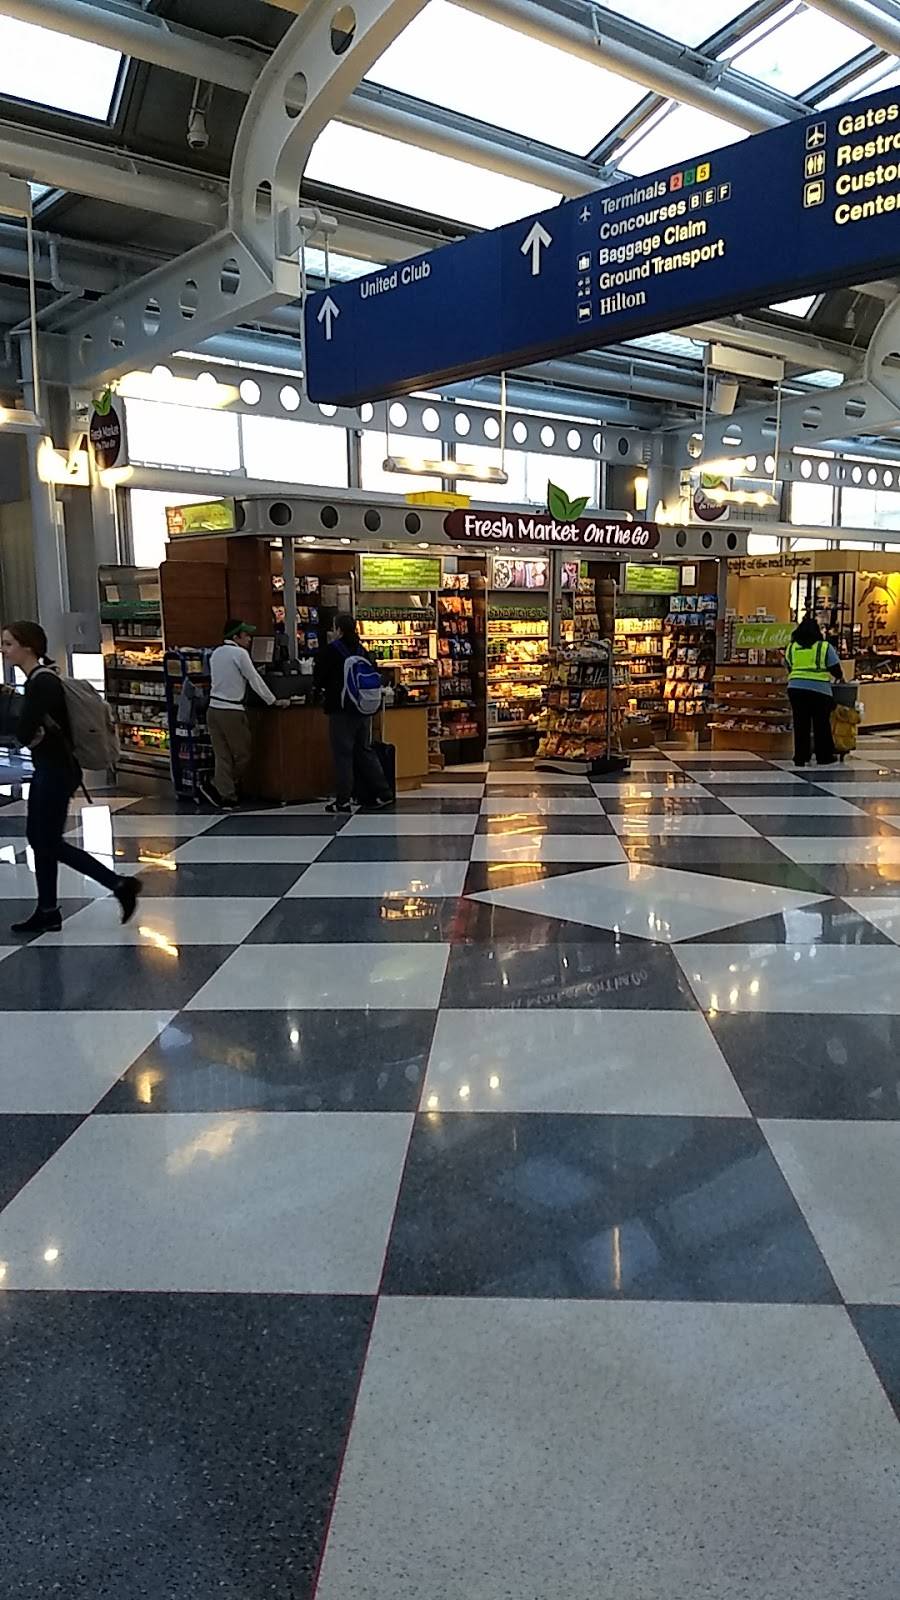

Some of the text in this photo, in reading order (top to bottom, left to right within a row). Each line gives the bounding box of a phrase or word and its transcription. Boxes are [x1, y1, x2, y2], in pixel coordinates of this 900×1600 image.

[838, 104, 899, 136] Gates
[835, 163, 900, 195] Custo
[600, 185, 729, 240] Concourses B E F
[601, 180, 666, 215] Terminals
[600, 220, 707, 266] Baggage Claim
[360, 260, 431, 299] United Club
[599, 239, 725, 290] Ground Transport
[600, 291, 646, 316] Hilton
[464, 515, 514, 539] Fresh
[518, 519, 580, 543] Market
